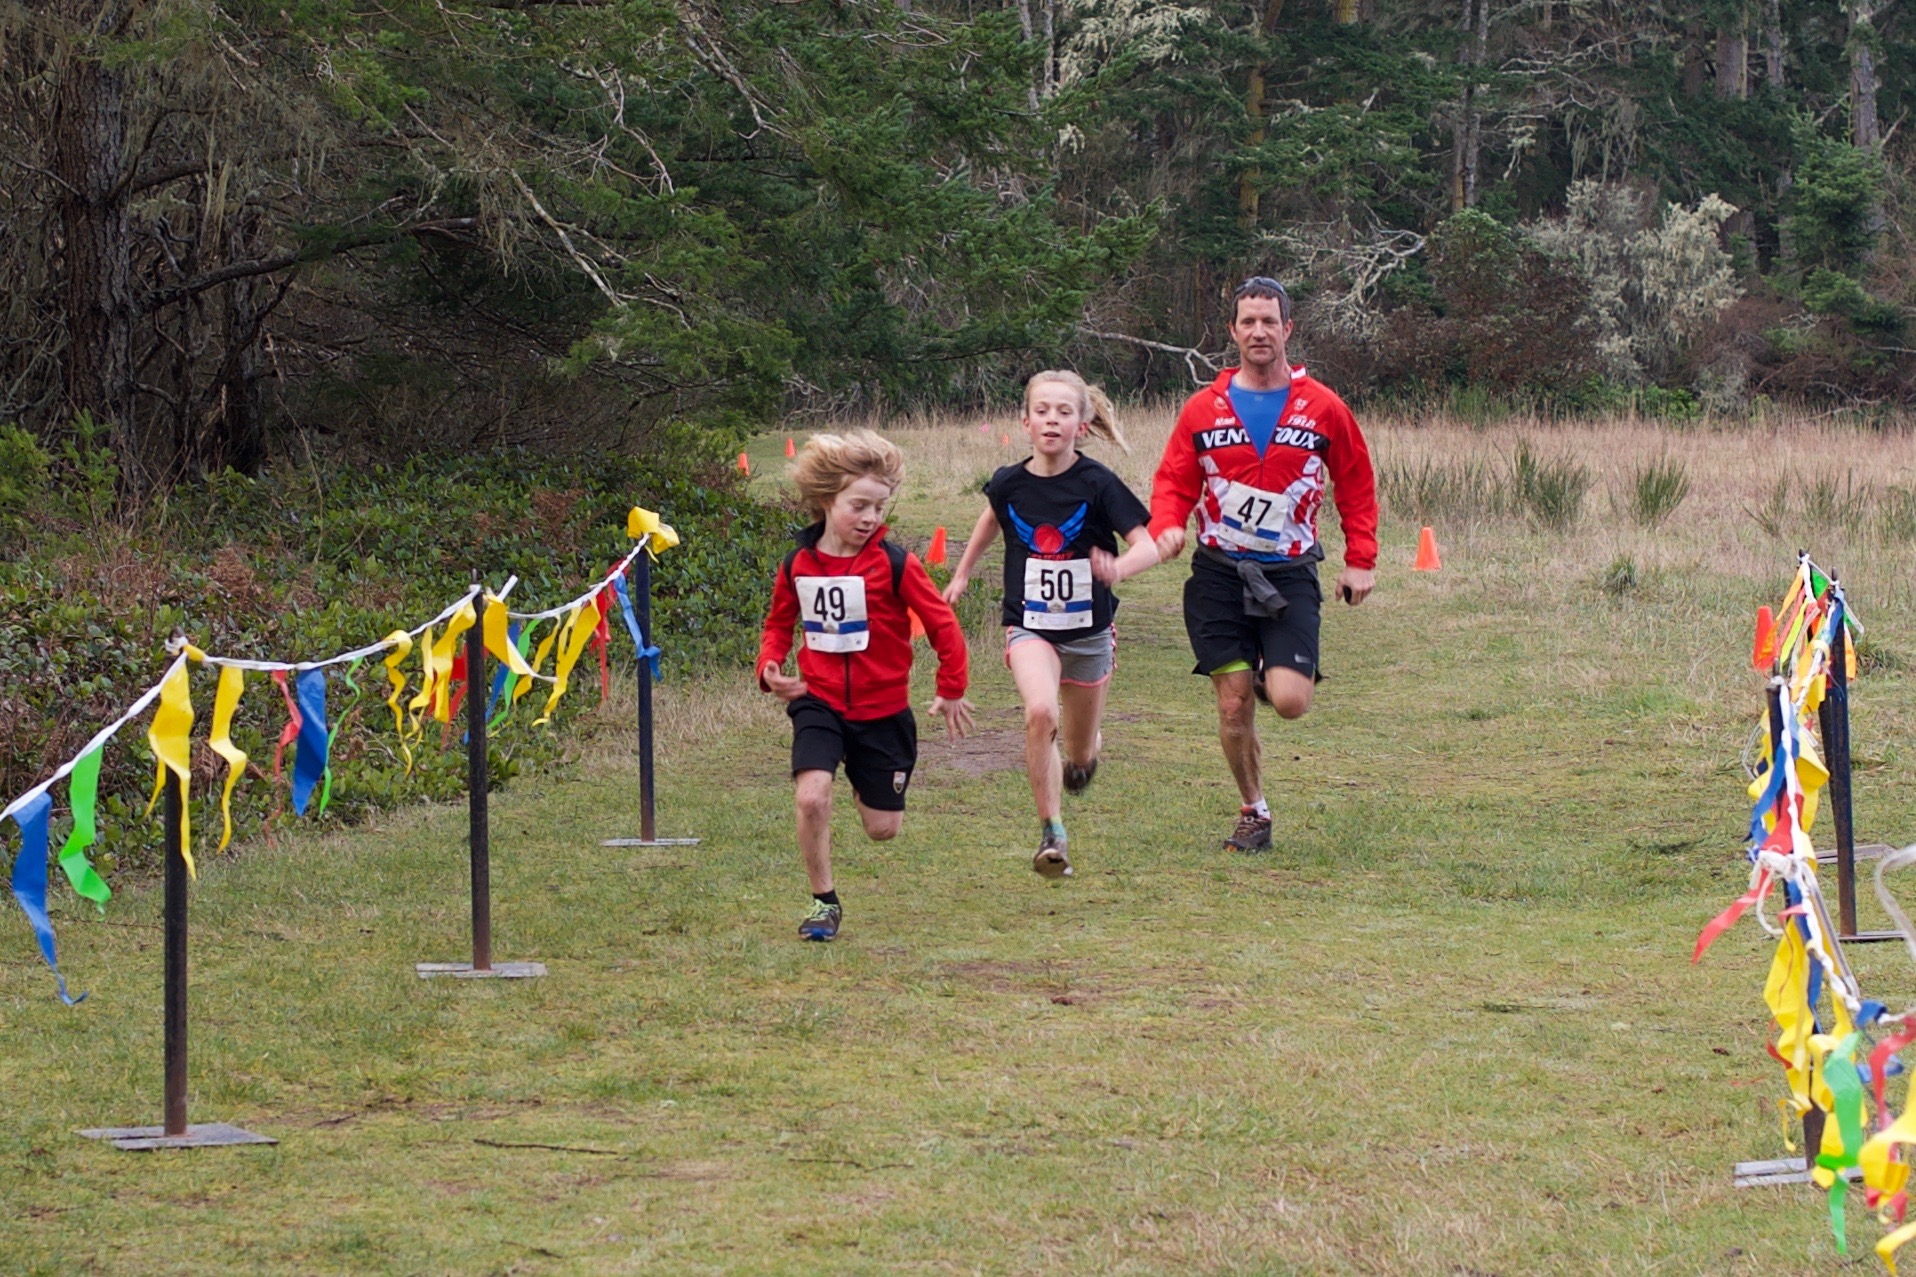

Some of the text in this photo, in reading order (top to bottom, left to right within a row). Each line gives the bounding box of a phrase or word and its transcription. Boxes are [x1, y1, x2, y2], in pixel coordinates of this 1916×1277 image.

[1237, 496, 1273, 526] 47
[1040, 568, 1074, 602] 50
[813, 586, 846, 621] 49
